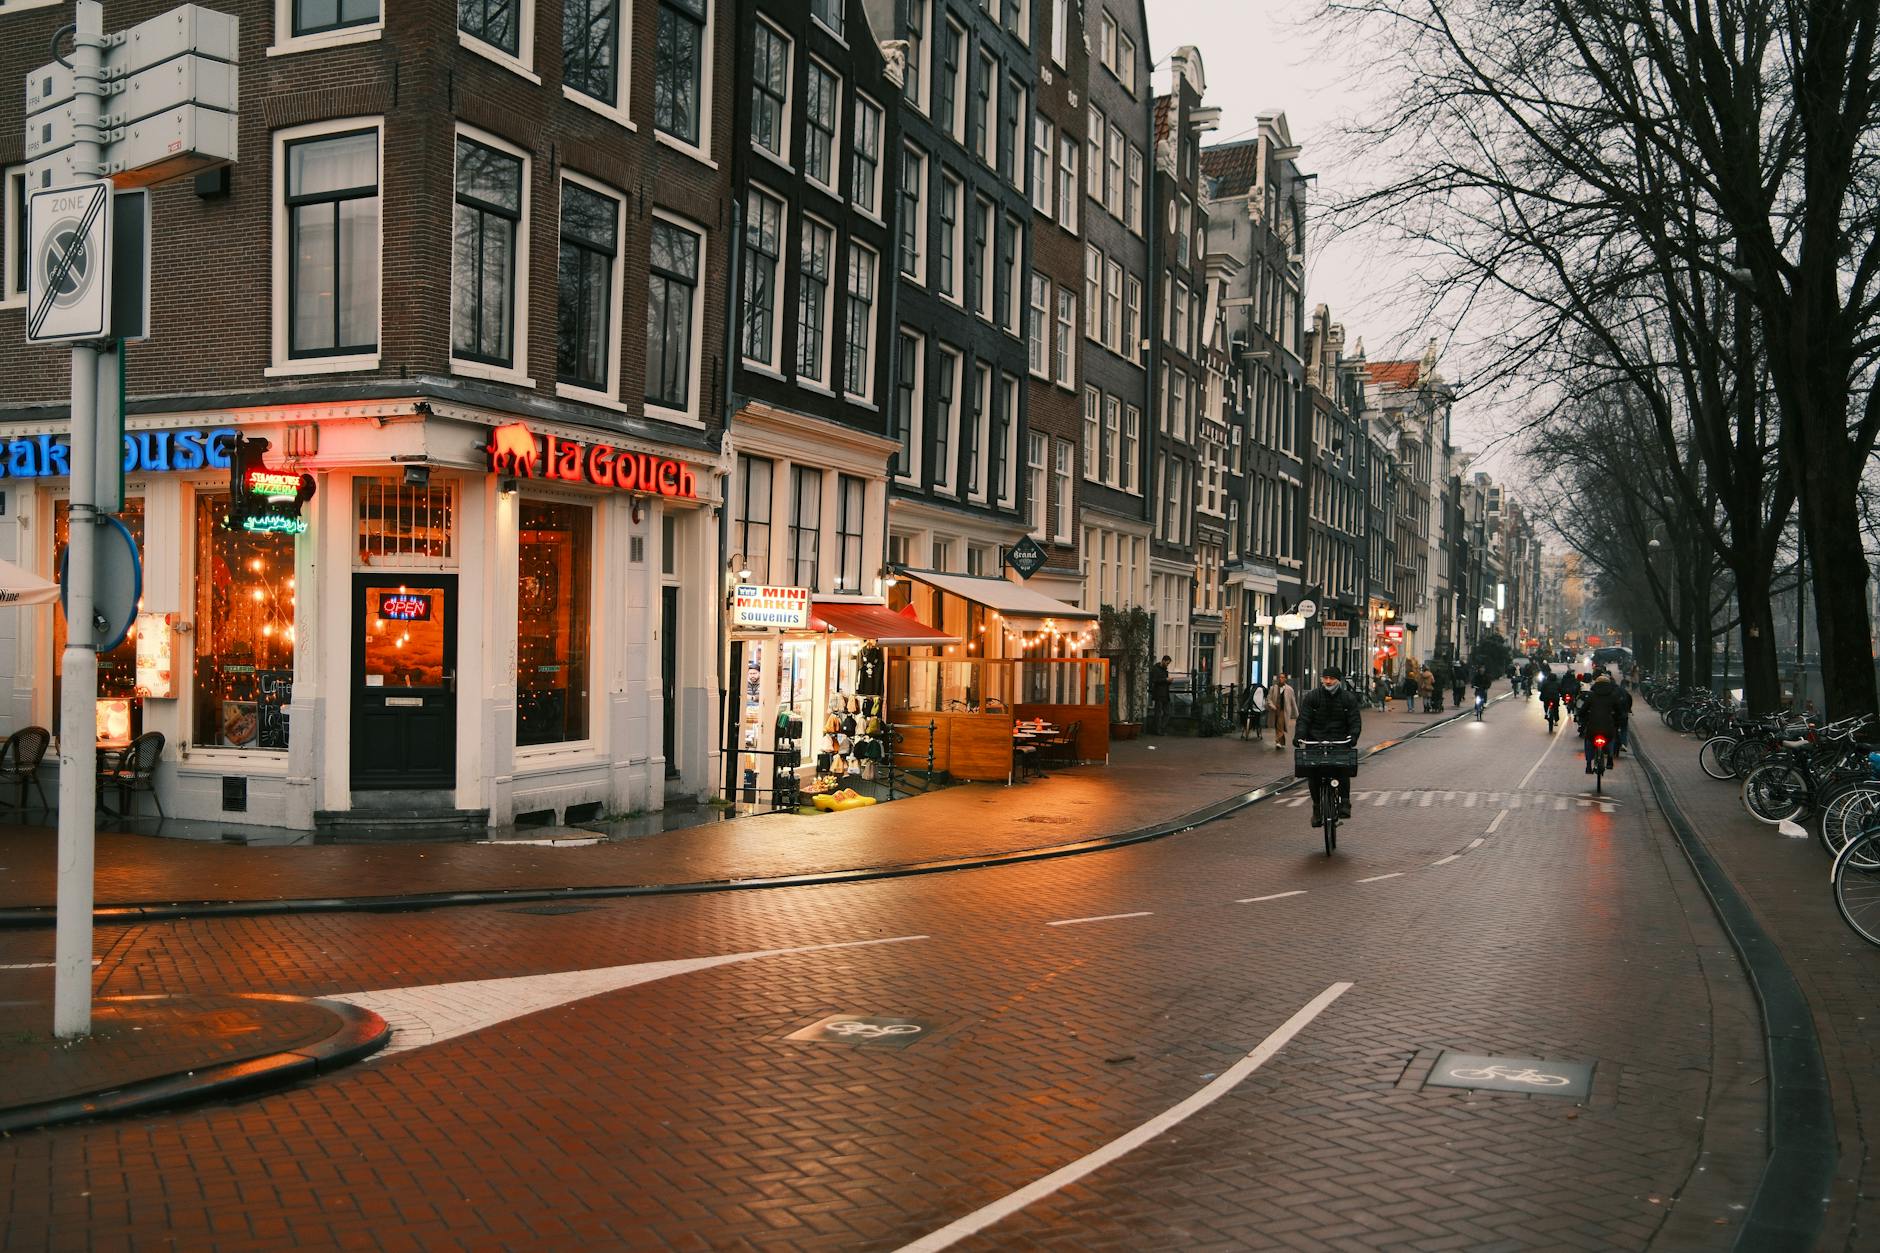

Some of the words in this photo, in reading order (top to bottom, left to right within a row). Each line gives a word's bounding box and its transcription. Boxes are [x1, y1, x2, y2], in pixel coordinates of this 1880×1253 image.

[52, 196, 84, 213] ZONE
[543, 434, 582, 482] la
[586, 443, 697, 499] Gouch
[1013, 550, 1037, 559] Brand
[762, 588, 806, 600] MINI
[383, 600, 425, 615] OPEN
[737, 597, 806, 611] MARKET
[741, 611, 799, 624] souvenirs
